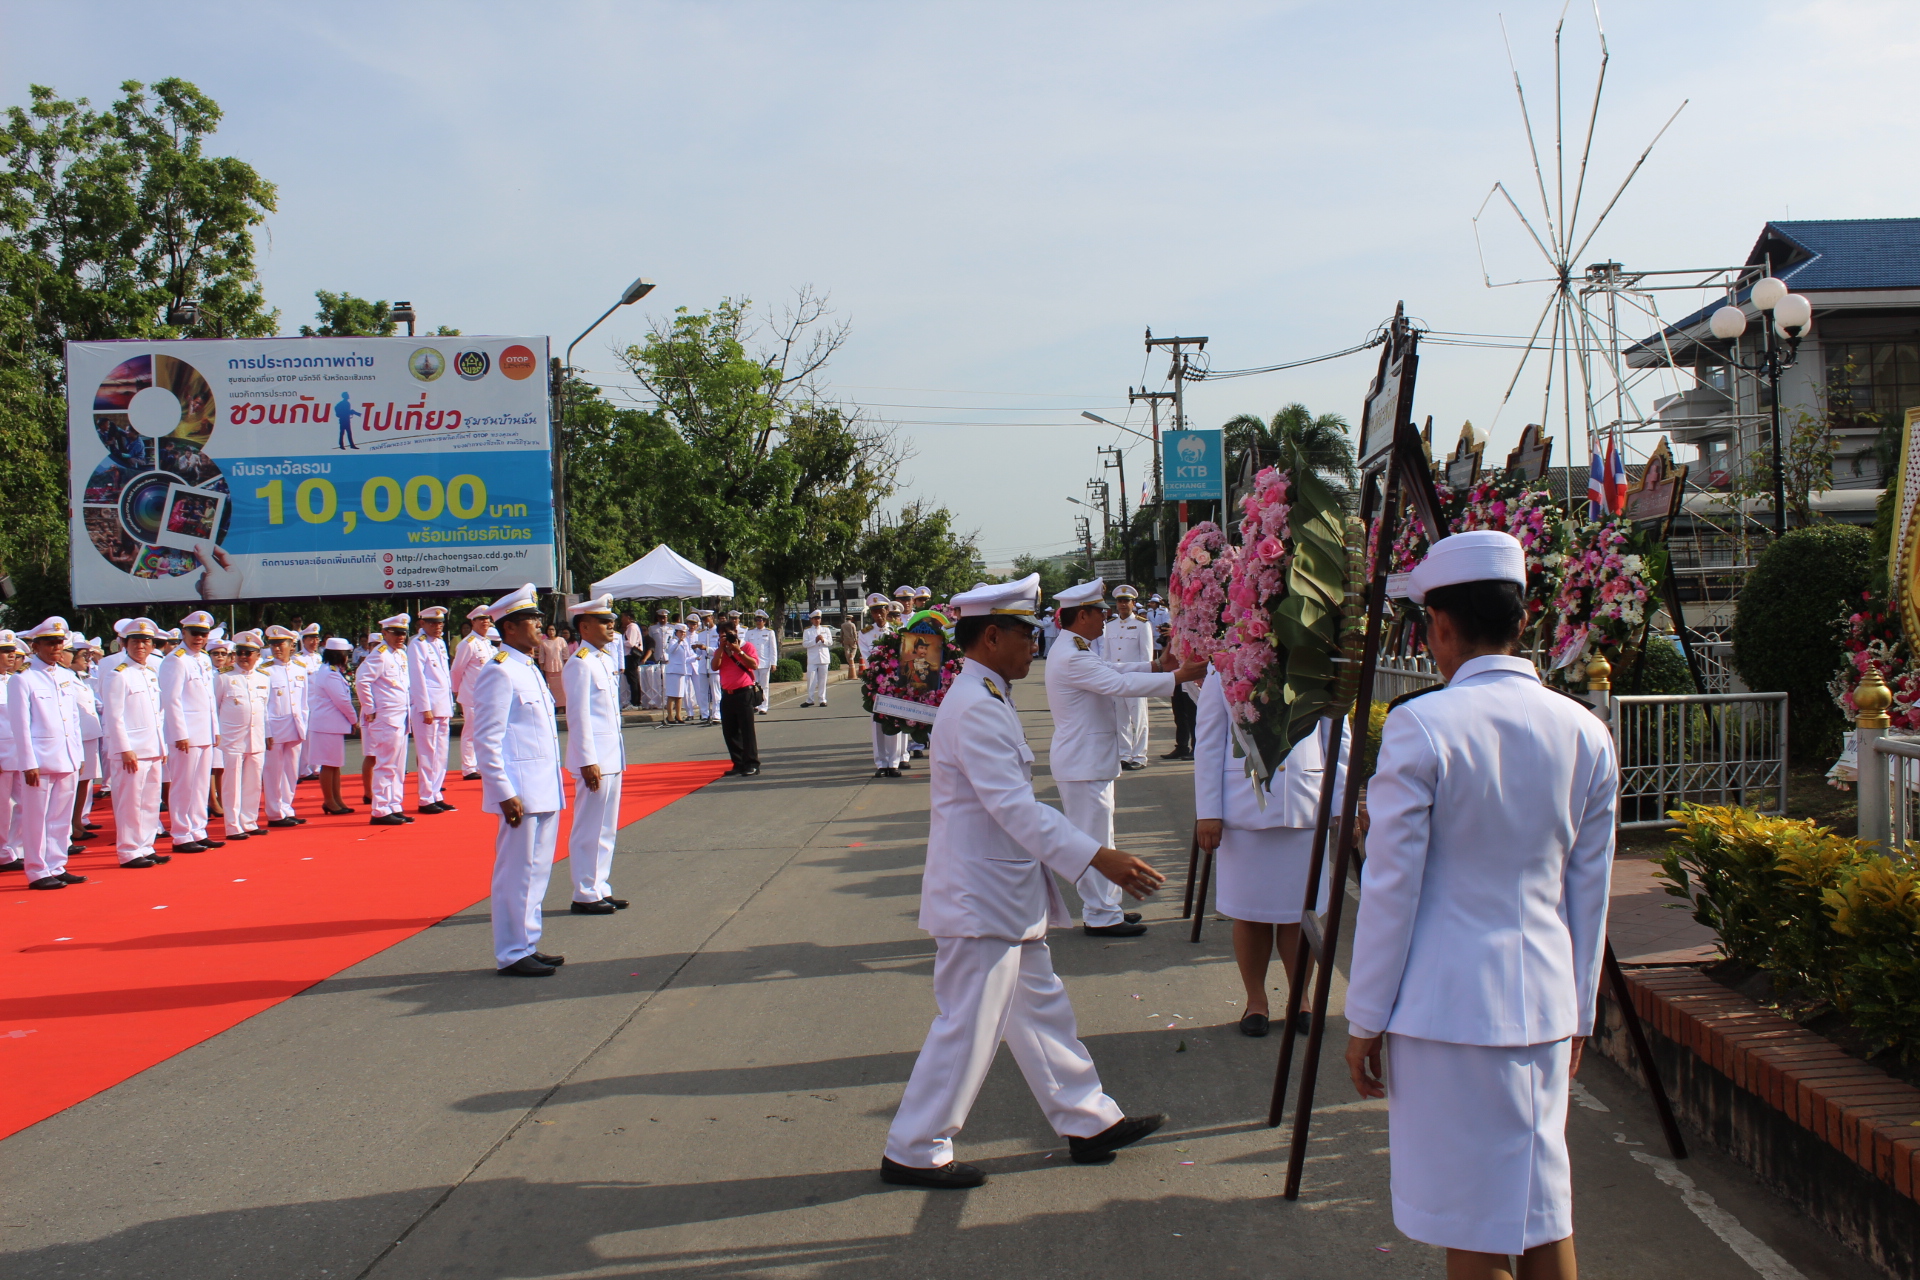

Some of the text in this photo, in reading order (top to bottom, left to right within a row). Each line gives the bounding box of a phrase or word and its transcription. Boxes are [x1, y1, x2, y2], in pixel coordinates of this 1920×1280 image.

[228, 352, 374, 369] การประกวดภาพถ่าย
[228, 373, 275, 385] ชุมชนท่องเที่ยว
[323, 373, 376, 382] จังหวัดฉะเชิงเทรา
[229, 389, 298, 398] แนวคิดการประกวด
[229, 392, 537, 431] ชวนกัน ไปเที่ยว ชุมชนบ้านฉัน
[232, 461, 331, 477] เงินรางวัลรวม
[1176, 465, 1208, 478] KTB
[255, 474, 487, 534] 10,000
[489, 502, 527, 518] บาท
[407, 525, 531, 543] พร้อมเกียรติบัตร
[261, 552, 377, 567] ติดตามรายละเอียดเพิ่มเติมได้ที่
[396, 549, 528, 563] http://chachoengsao.cdd.go.th/
[396, 565, 499, 576] cdpadrew@hotmail.com
[397, 579, 450, 588] 038-511-239
